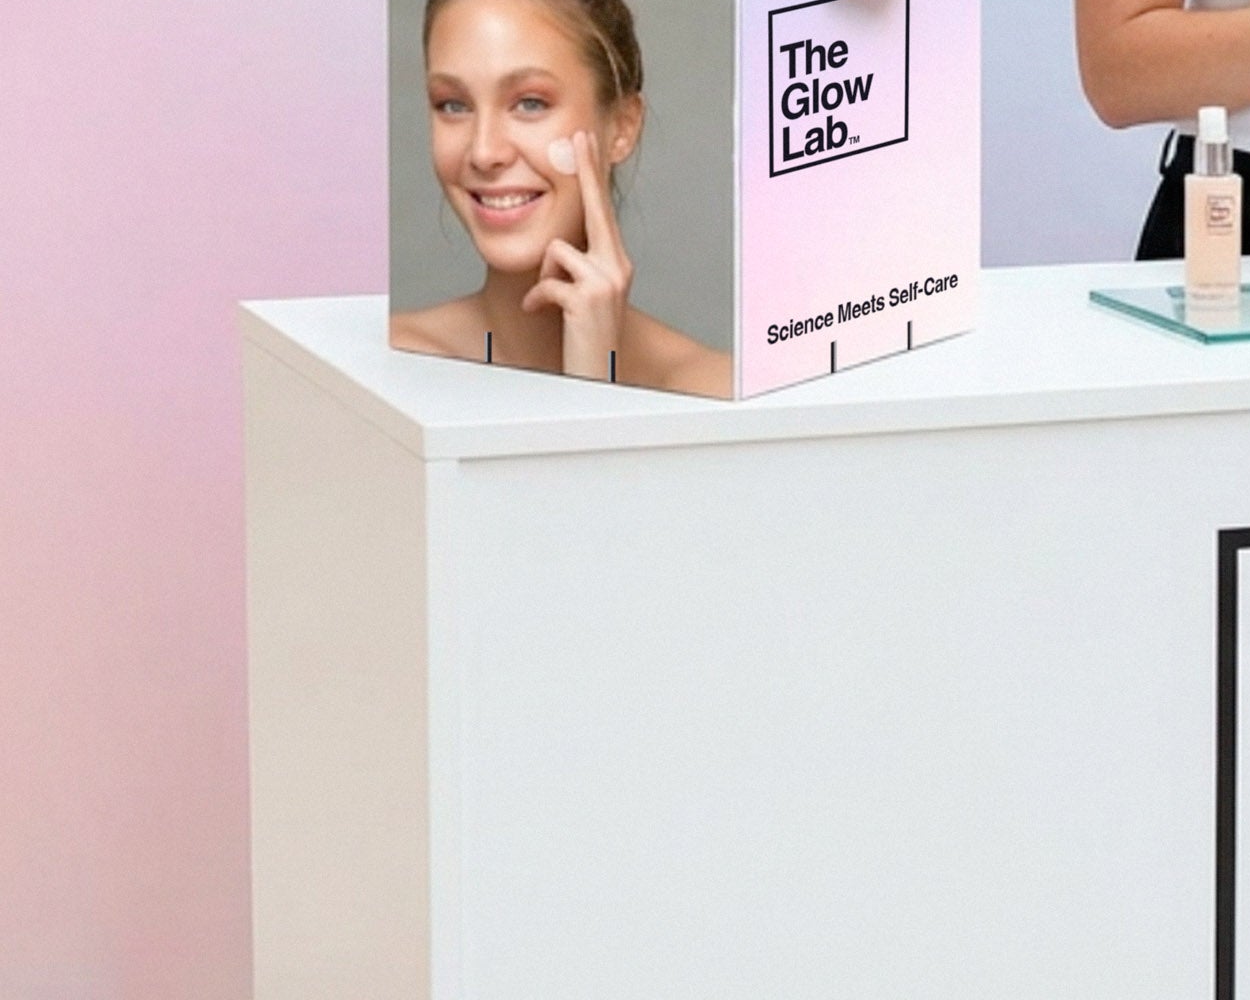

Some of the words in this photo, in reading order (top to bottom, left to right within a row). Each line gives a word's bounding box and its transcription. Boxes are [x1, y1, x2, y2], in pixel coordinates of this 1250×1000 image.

[779, 38, 849, 79] The
[781, 73, 874, 121] Glow
[767, 312, 834, 345] Science
[838, 294, 885, 324] Meets
[889, 273, 959, 307] Self-Care
